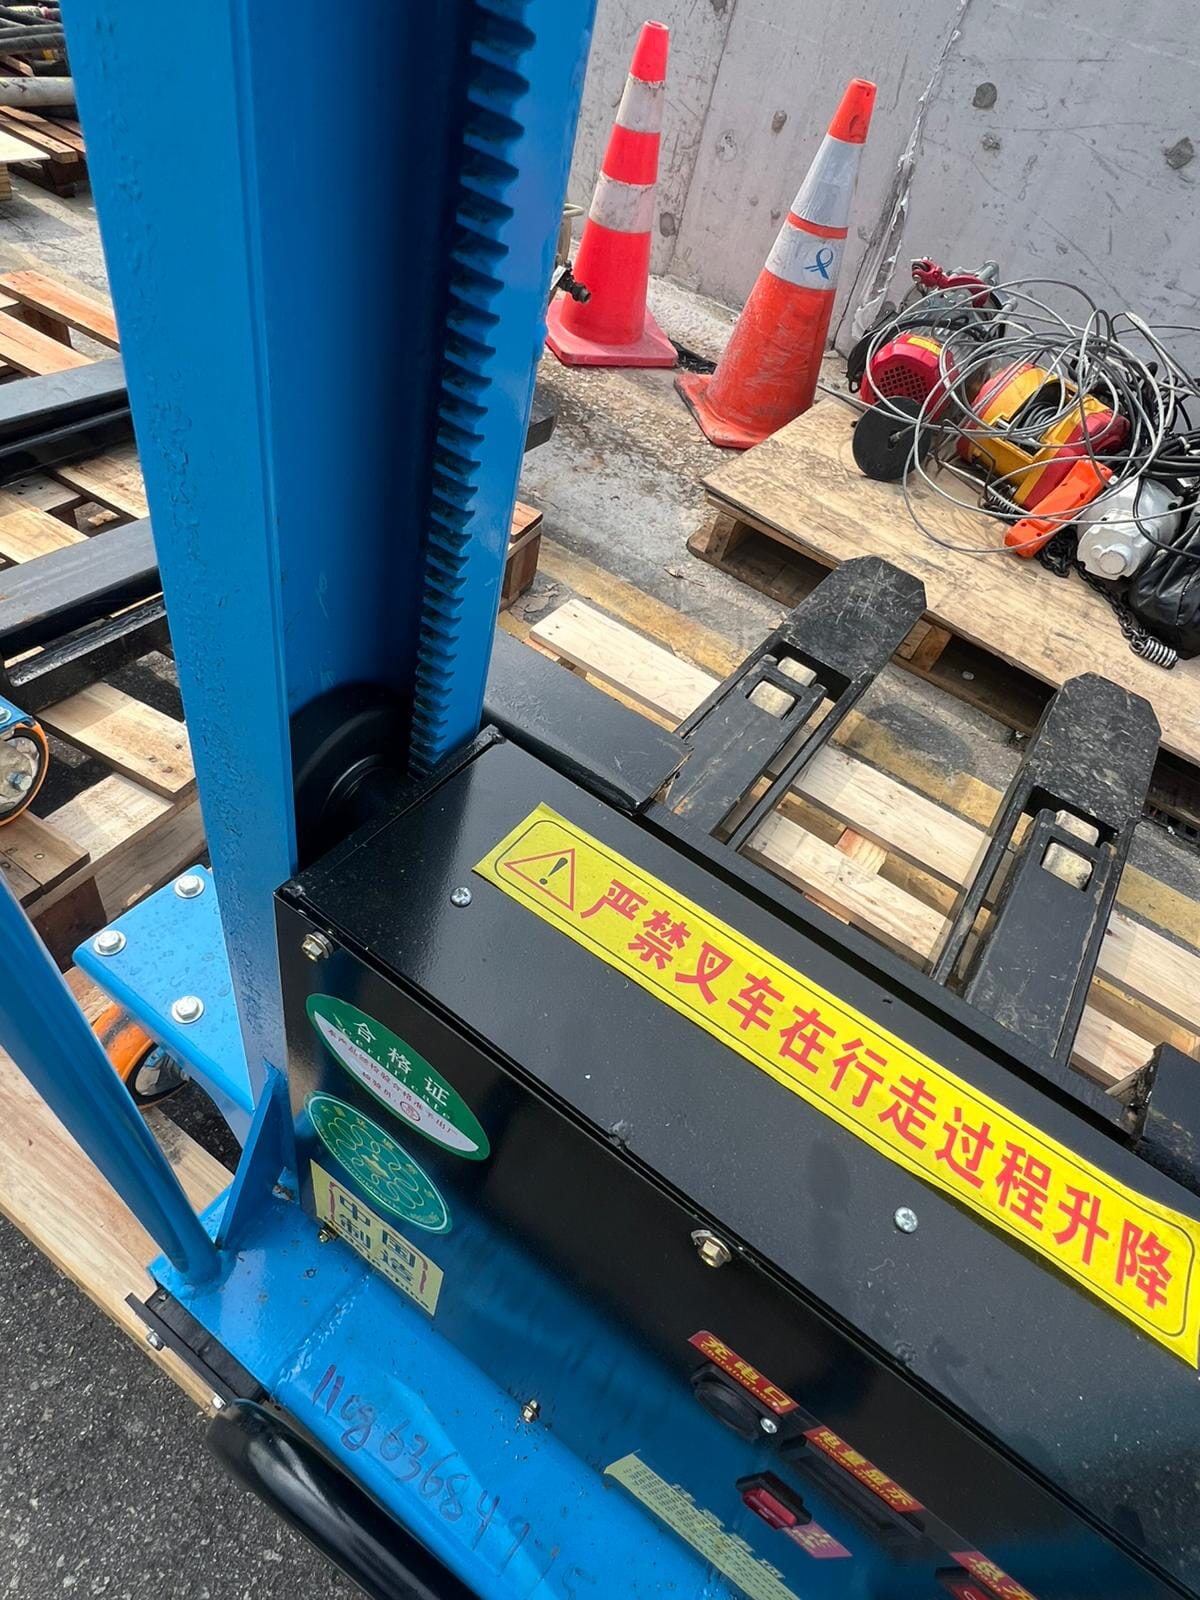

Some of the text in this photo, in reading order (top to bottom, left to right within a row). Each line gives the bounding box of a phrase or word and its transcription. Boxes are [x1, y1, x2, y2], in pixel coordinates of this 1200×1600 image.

[352, 1021, 450, 1107] 合格证
[580, 878, 1173, 1310] 严禁叉车在行走过程升降
[339, 1195, 416, 1268] 中国
[702, 1335, 793, 1407] 充电口
[818, 1431, 914, 1505] 电量显示
